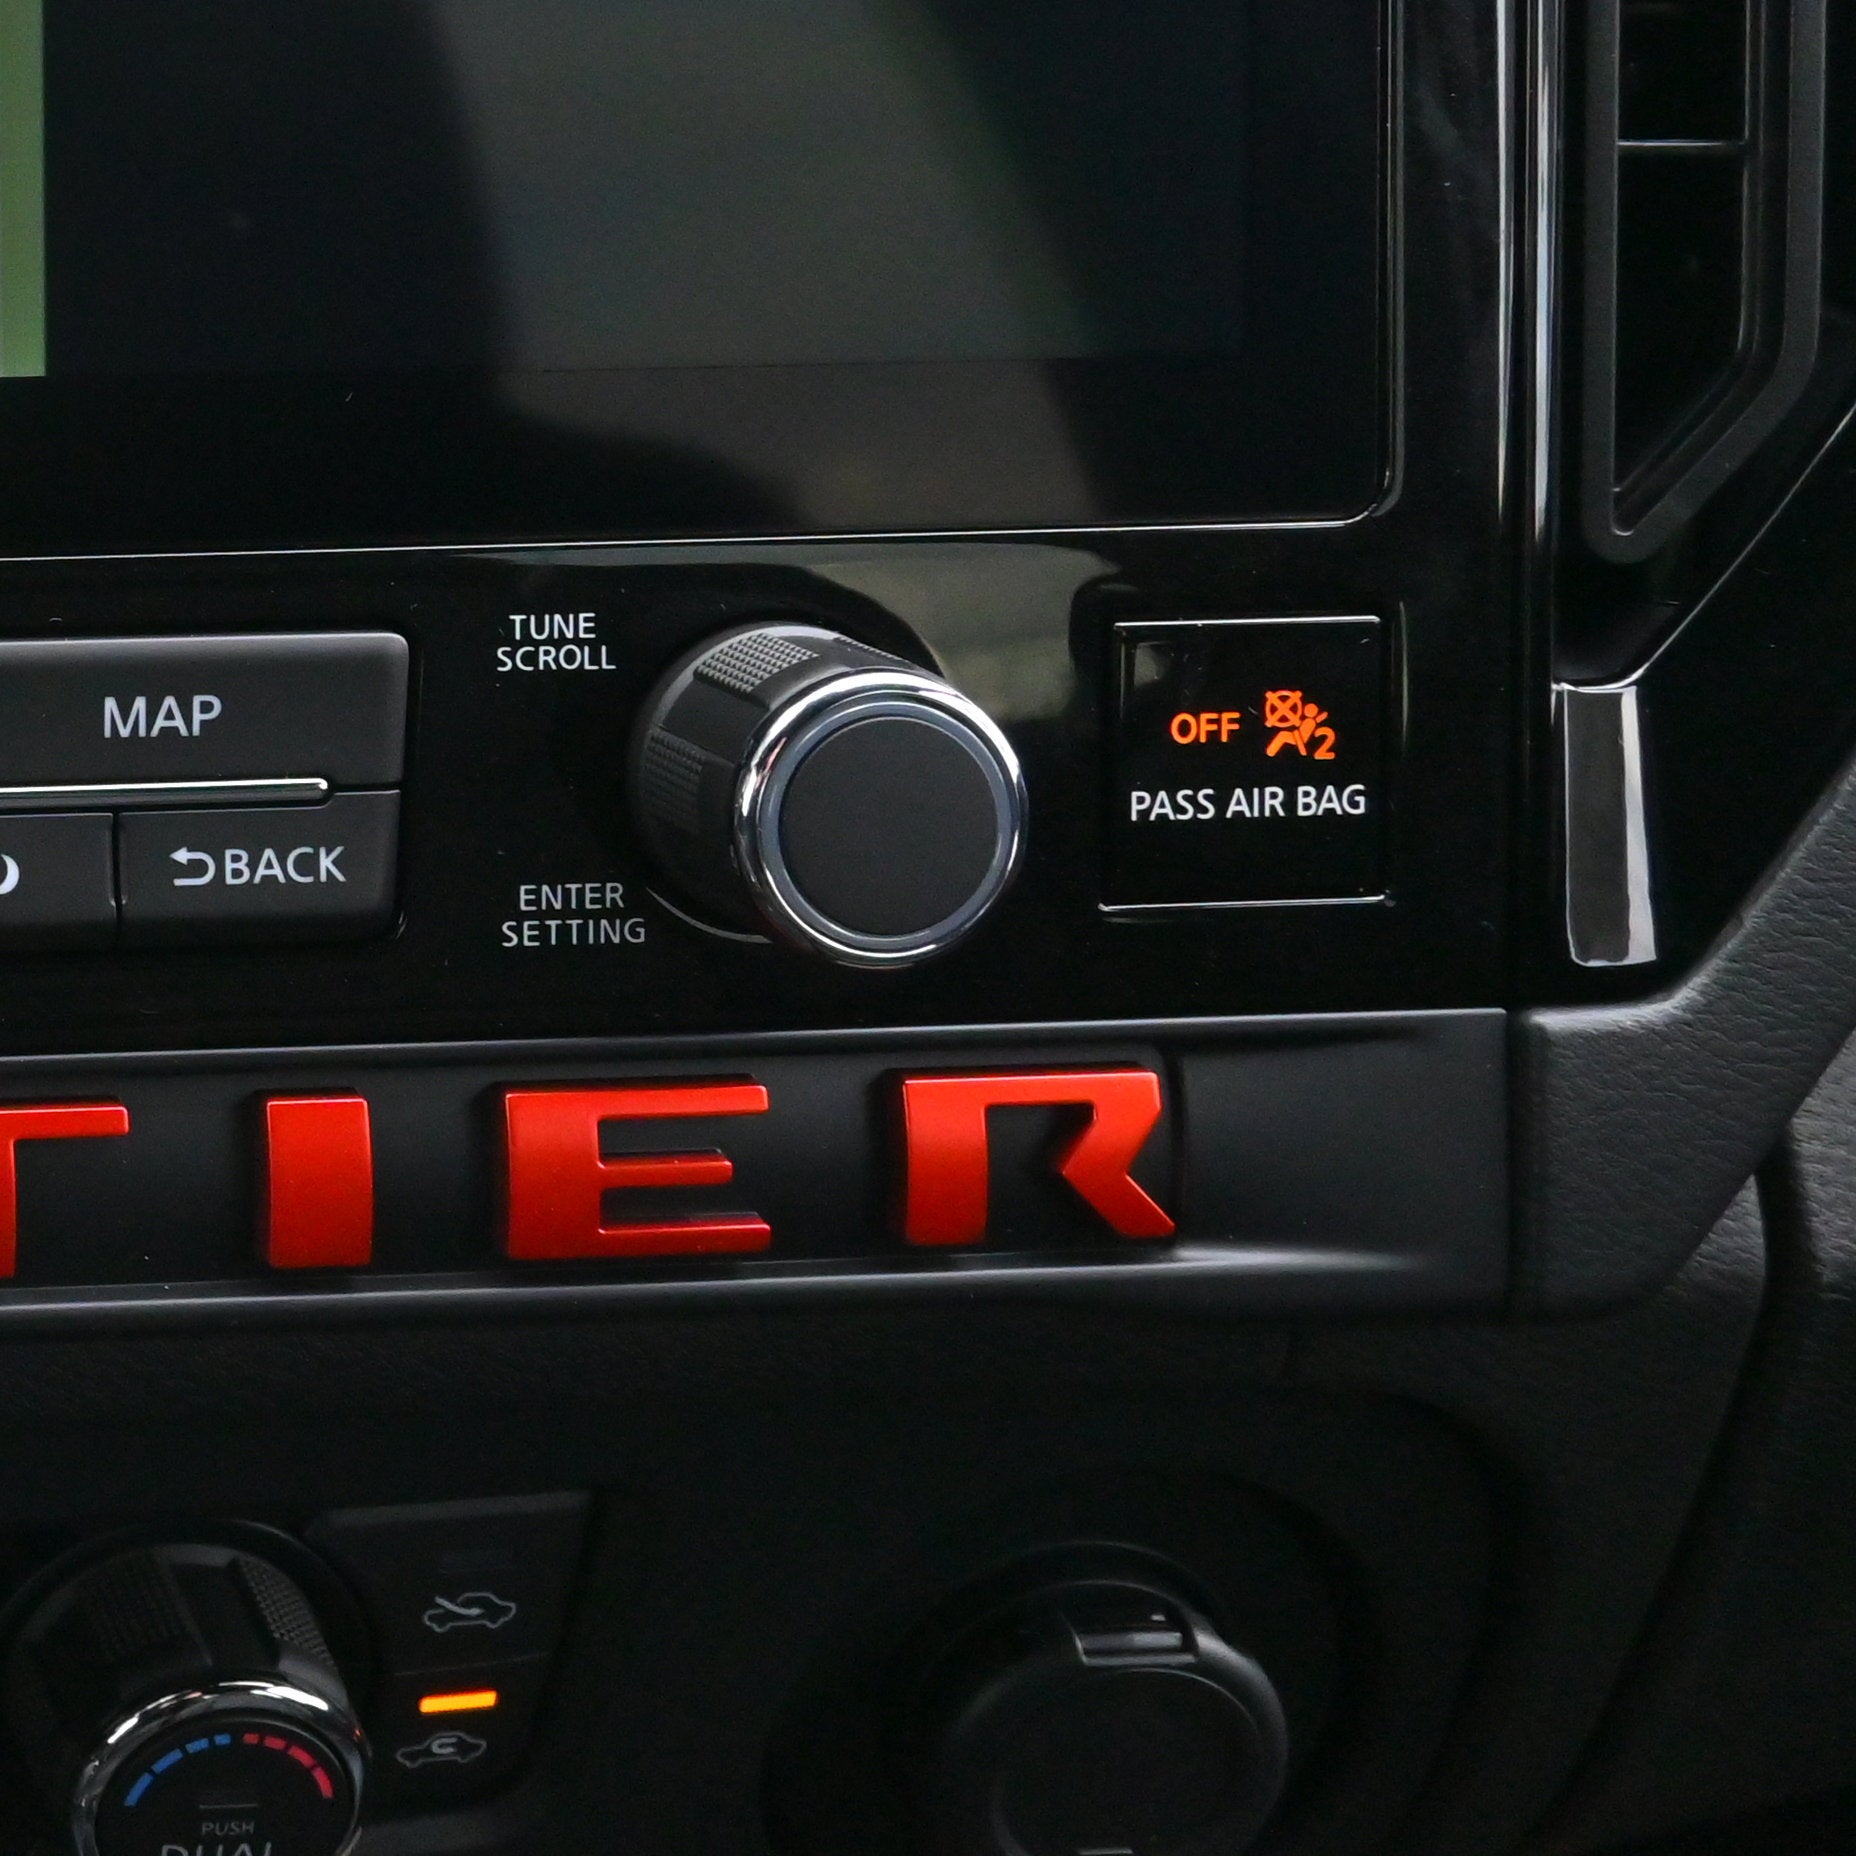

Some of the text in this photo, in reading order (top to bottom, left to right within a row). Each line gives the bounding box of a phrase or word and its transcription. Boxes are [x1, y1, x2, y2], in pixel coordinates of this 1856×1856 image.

[509, 612, 596, 641] TUNE
[496, 644, 616, 672] SCROLL
[103, 694, 222, 738] MAP
[1169, 711, 1241, 745] OFF
[1130, 783, 1366, 822] PASS AIR BAG
[224, 846, 346, 885] BACK
[519, 882, 624, 912] ENTER
[501, 918, 645, 948] SETTING
[201, 1821, 255, 1836] PUSH
